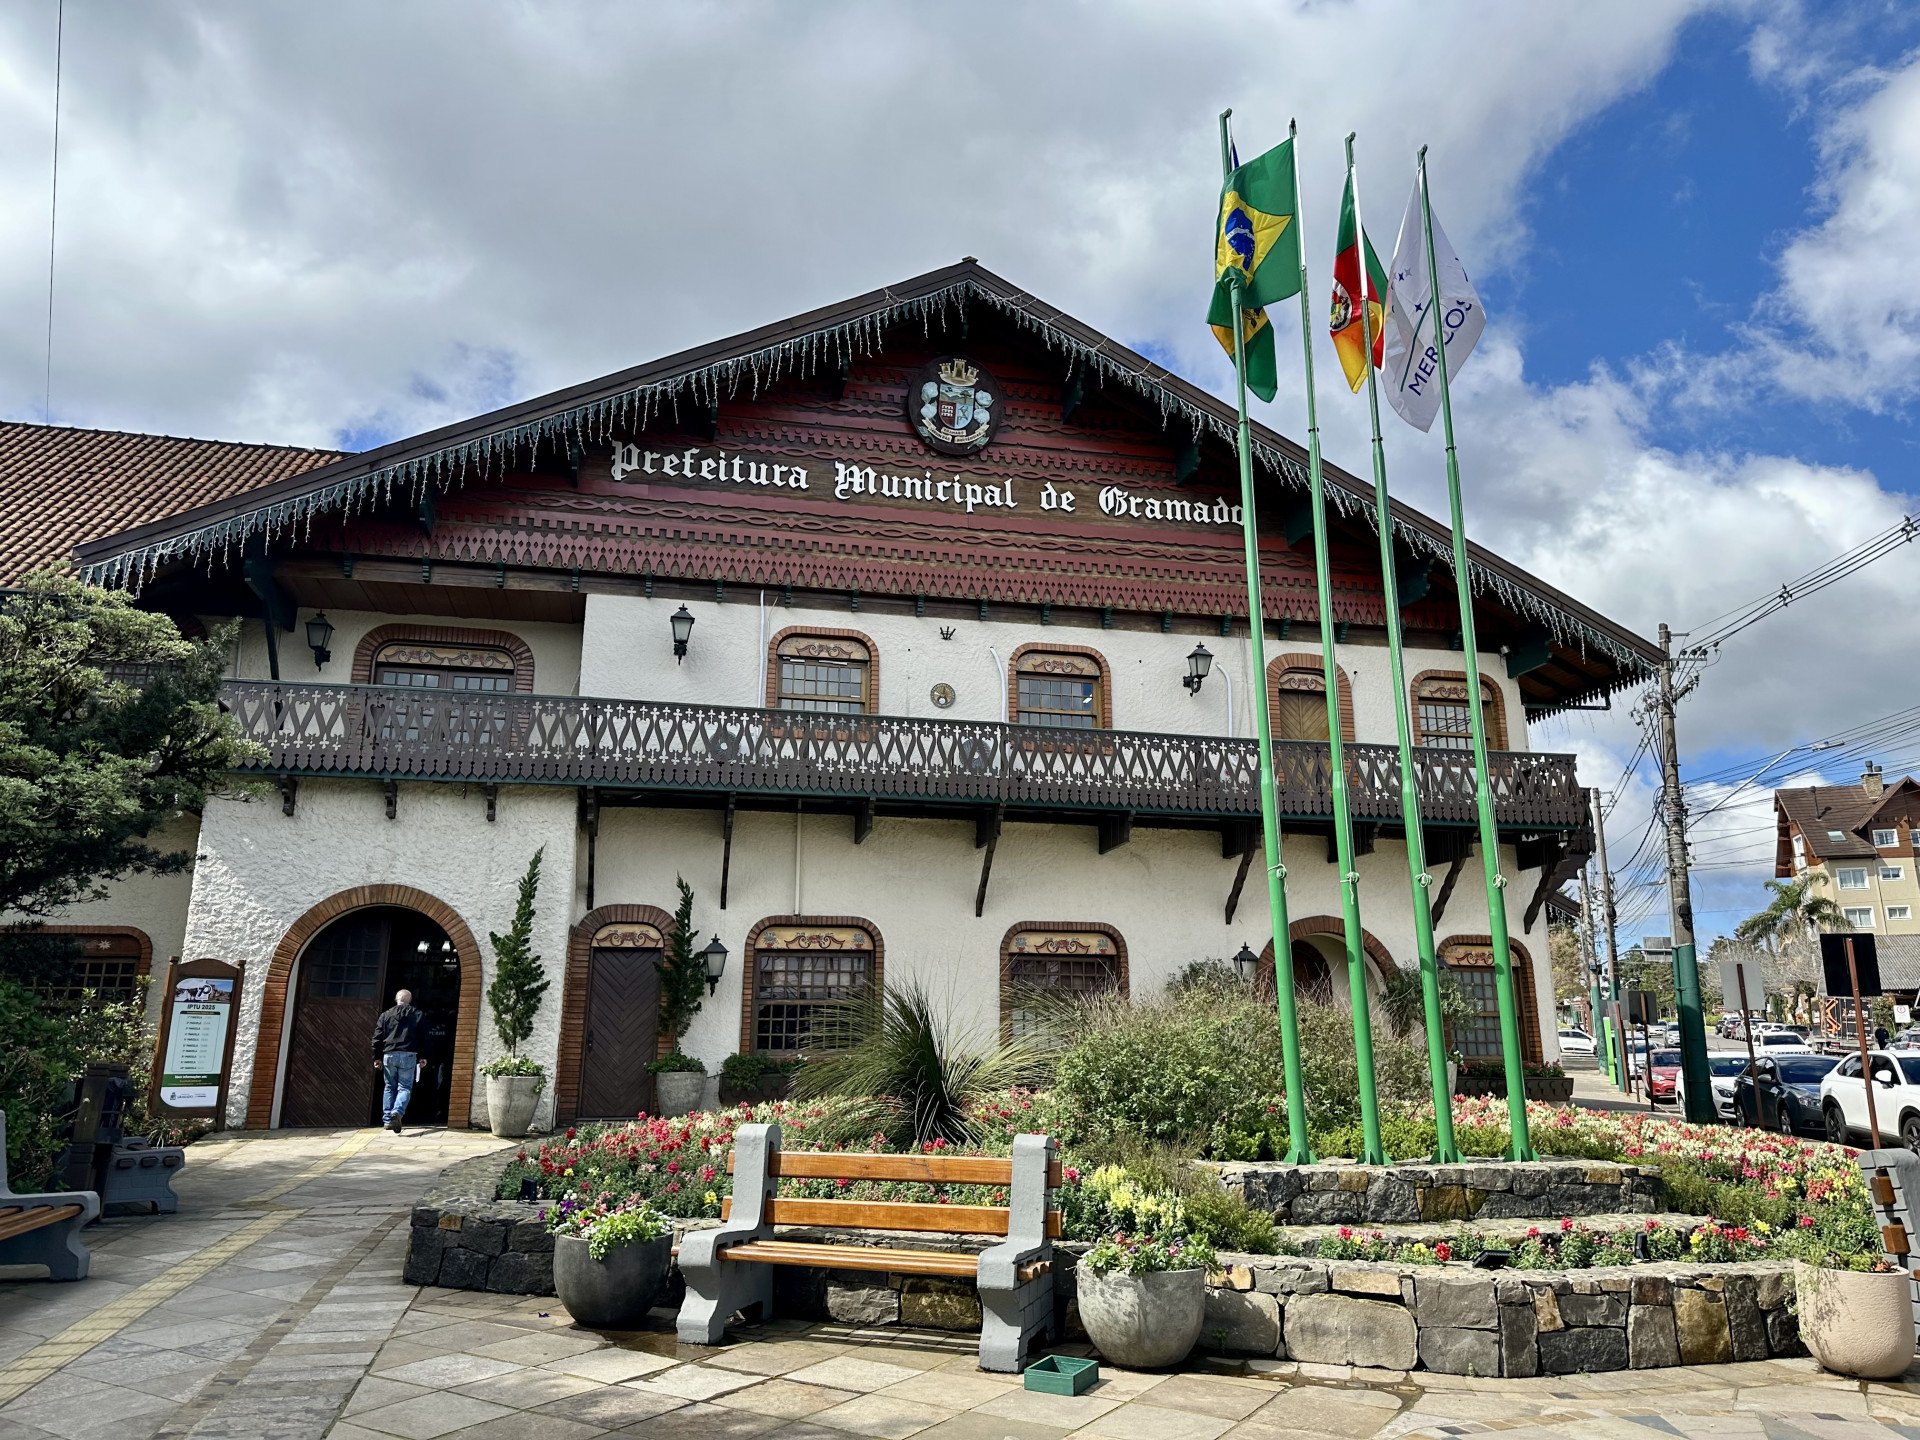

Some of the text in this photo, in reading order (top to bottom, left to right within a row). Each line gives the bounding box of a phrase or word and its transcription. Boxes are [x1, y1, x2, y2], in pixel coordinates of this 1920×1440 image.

[611, 440, 1245, 526] Prefeitura Municipal de Gramado
